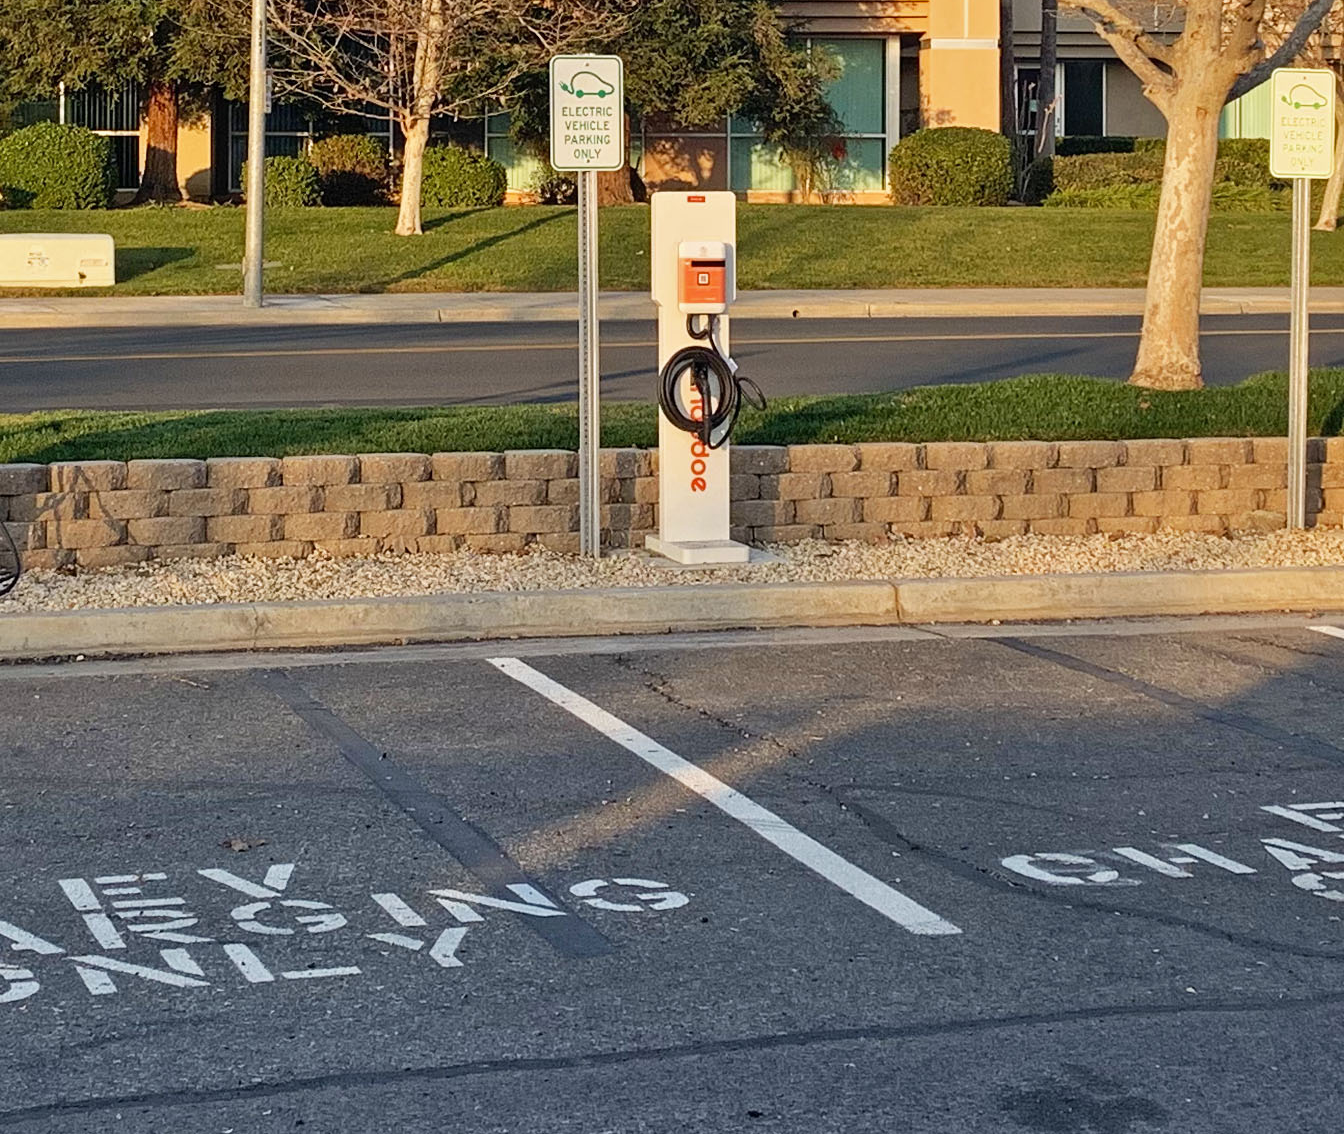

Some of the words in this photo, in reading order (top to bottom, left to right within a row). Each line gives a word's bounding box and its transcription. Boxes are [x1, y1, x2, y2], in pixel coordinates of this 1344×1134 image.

[561, 106, 613, 117] ELECTRIC
[564, 120, 610, 131] VEHICLE
[564, 134, 611, 145] PARKING
[573, 148, 601, 159] ONLY
[58, 863, 296, 912] EV
